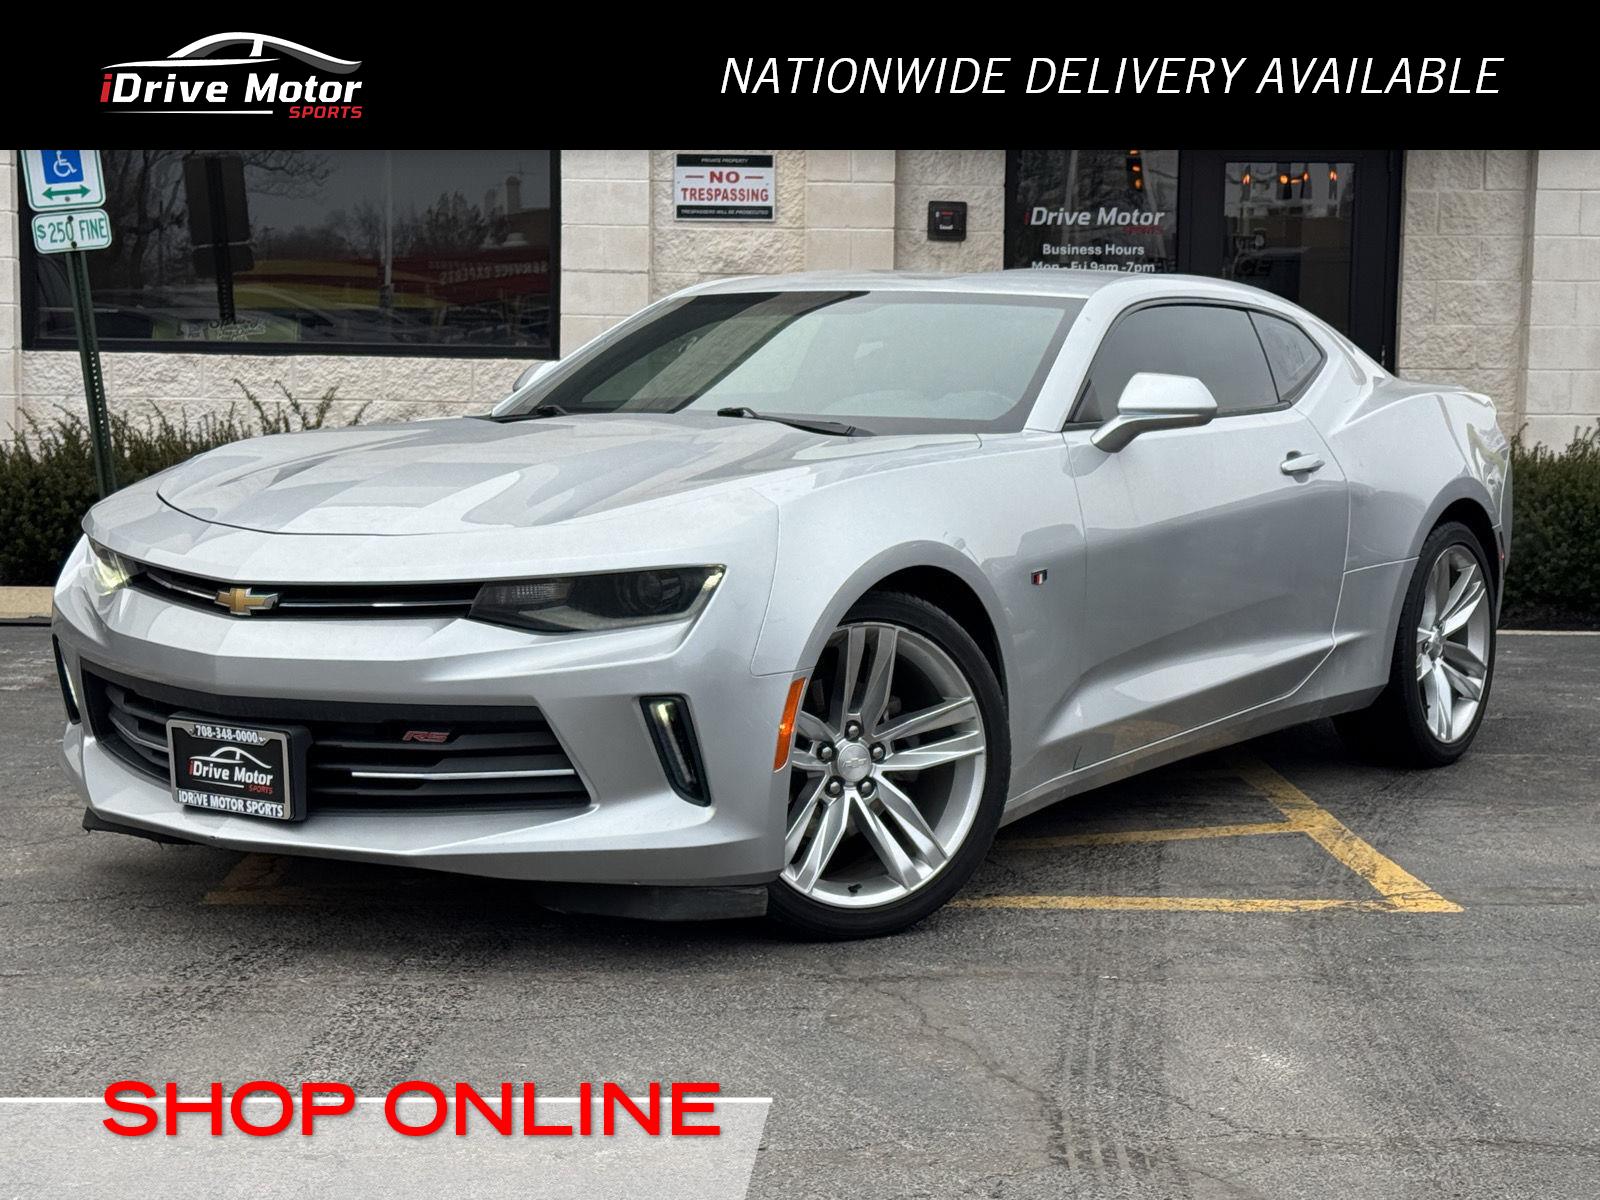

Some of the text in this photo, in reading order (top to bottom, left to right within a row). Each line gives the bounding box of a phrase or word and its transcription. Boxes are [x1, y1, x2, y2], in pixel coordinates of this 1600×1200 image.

[709, 171, 740, 184] NO
[681, 187, 769, 203] TRESPASSING
[1097, 206, 1166, 226] Motor
[79, 217, 108, 241] FINE
[1042, 243, 1145, 256] Business Hours
[1090, 261, 1119, 273] 9am
[195, 724, 259, 743] 708-348-0000
[402, 730, 450, 743] RS
[187, 760, 273, 786] iDrive Motor
[248, 784, 273, 795] SPORTS
[209, 795, 245, 812] MOTOR
